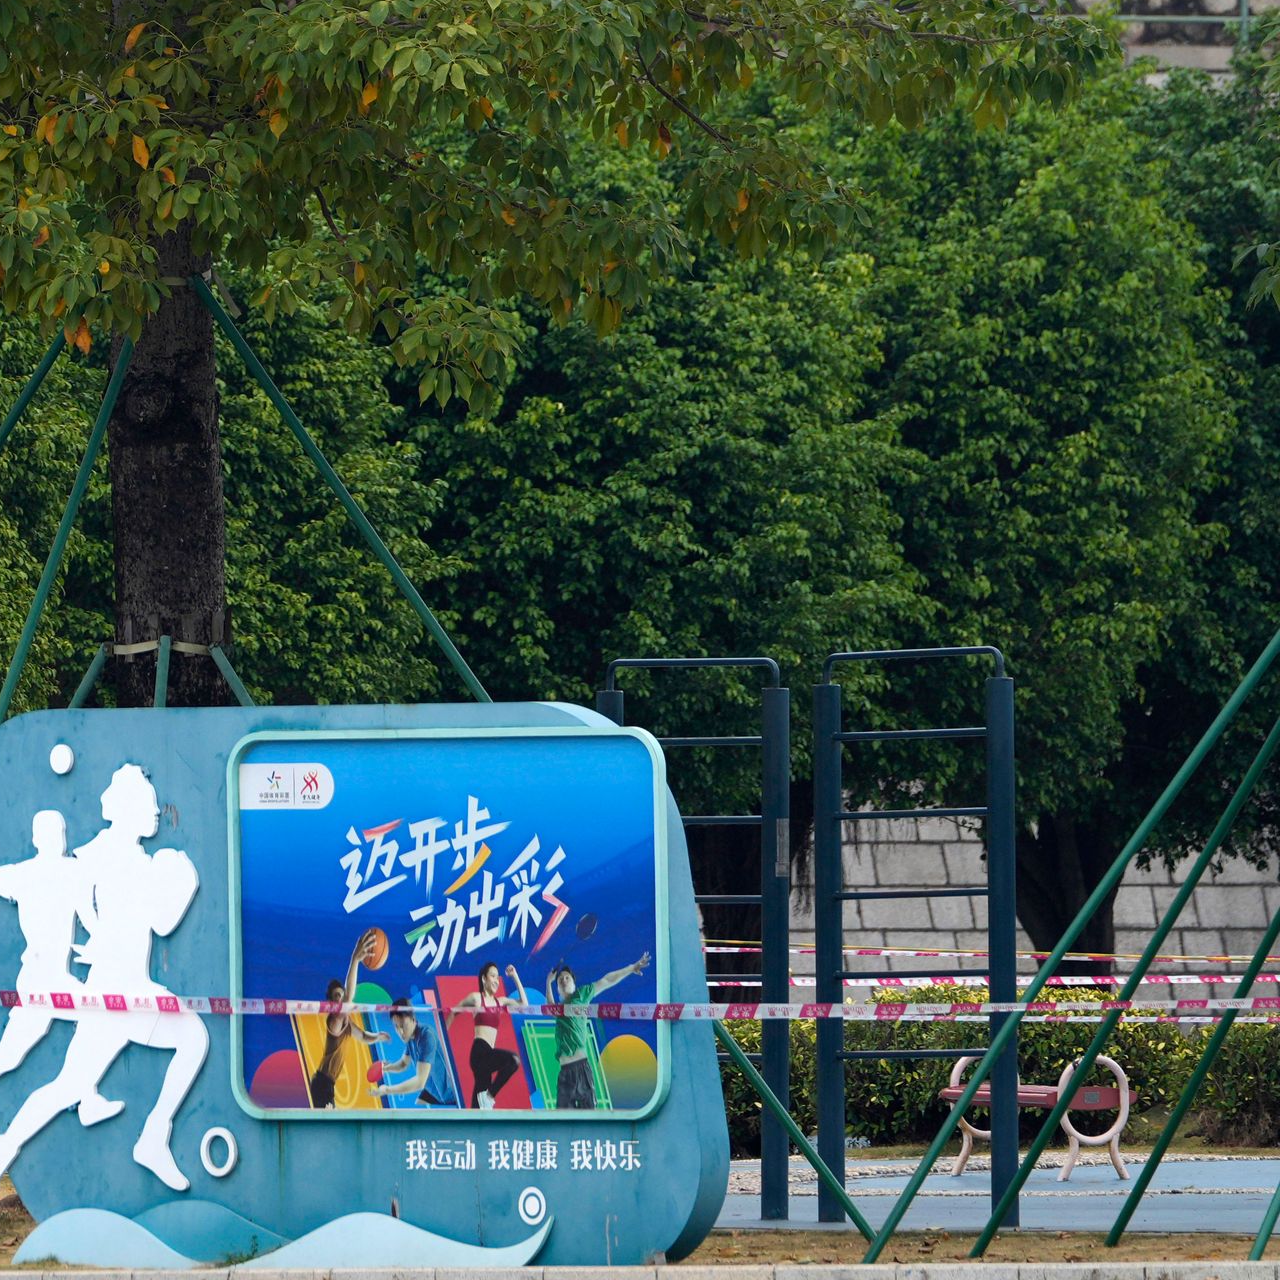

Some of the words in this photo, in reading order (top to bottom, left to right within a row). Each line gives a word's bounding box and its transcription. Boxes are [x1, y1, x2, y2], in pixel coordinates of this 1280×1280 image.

[339, 794, 513, 914] 迈开步
[404, 832, 570, 974] 动出彩
[406, 1139, 476, 1170] 我运动
[488, 1139, 558, 1170] 我健康
[570, 1139, 641, 1170] 我快乐
